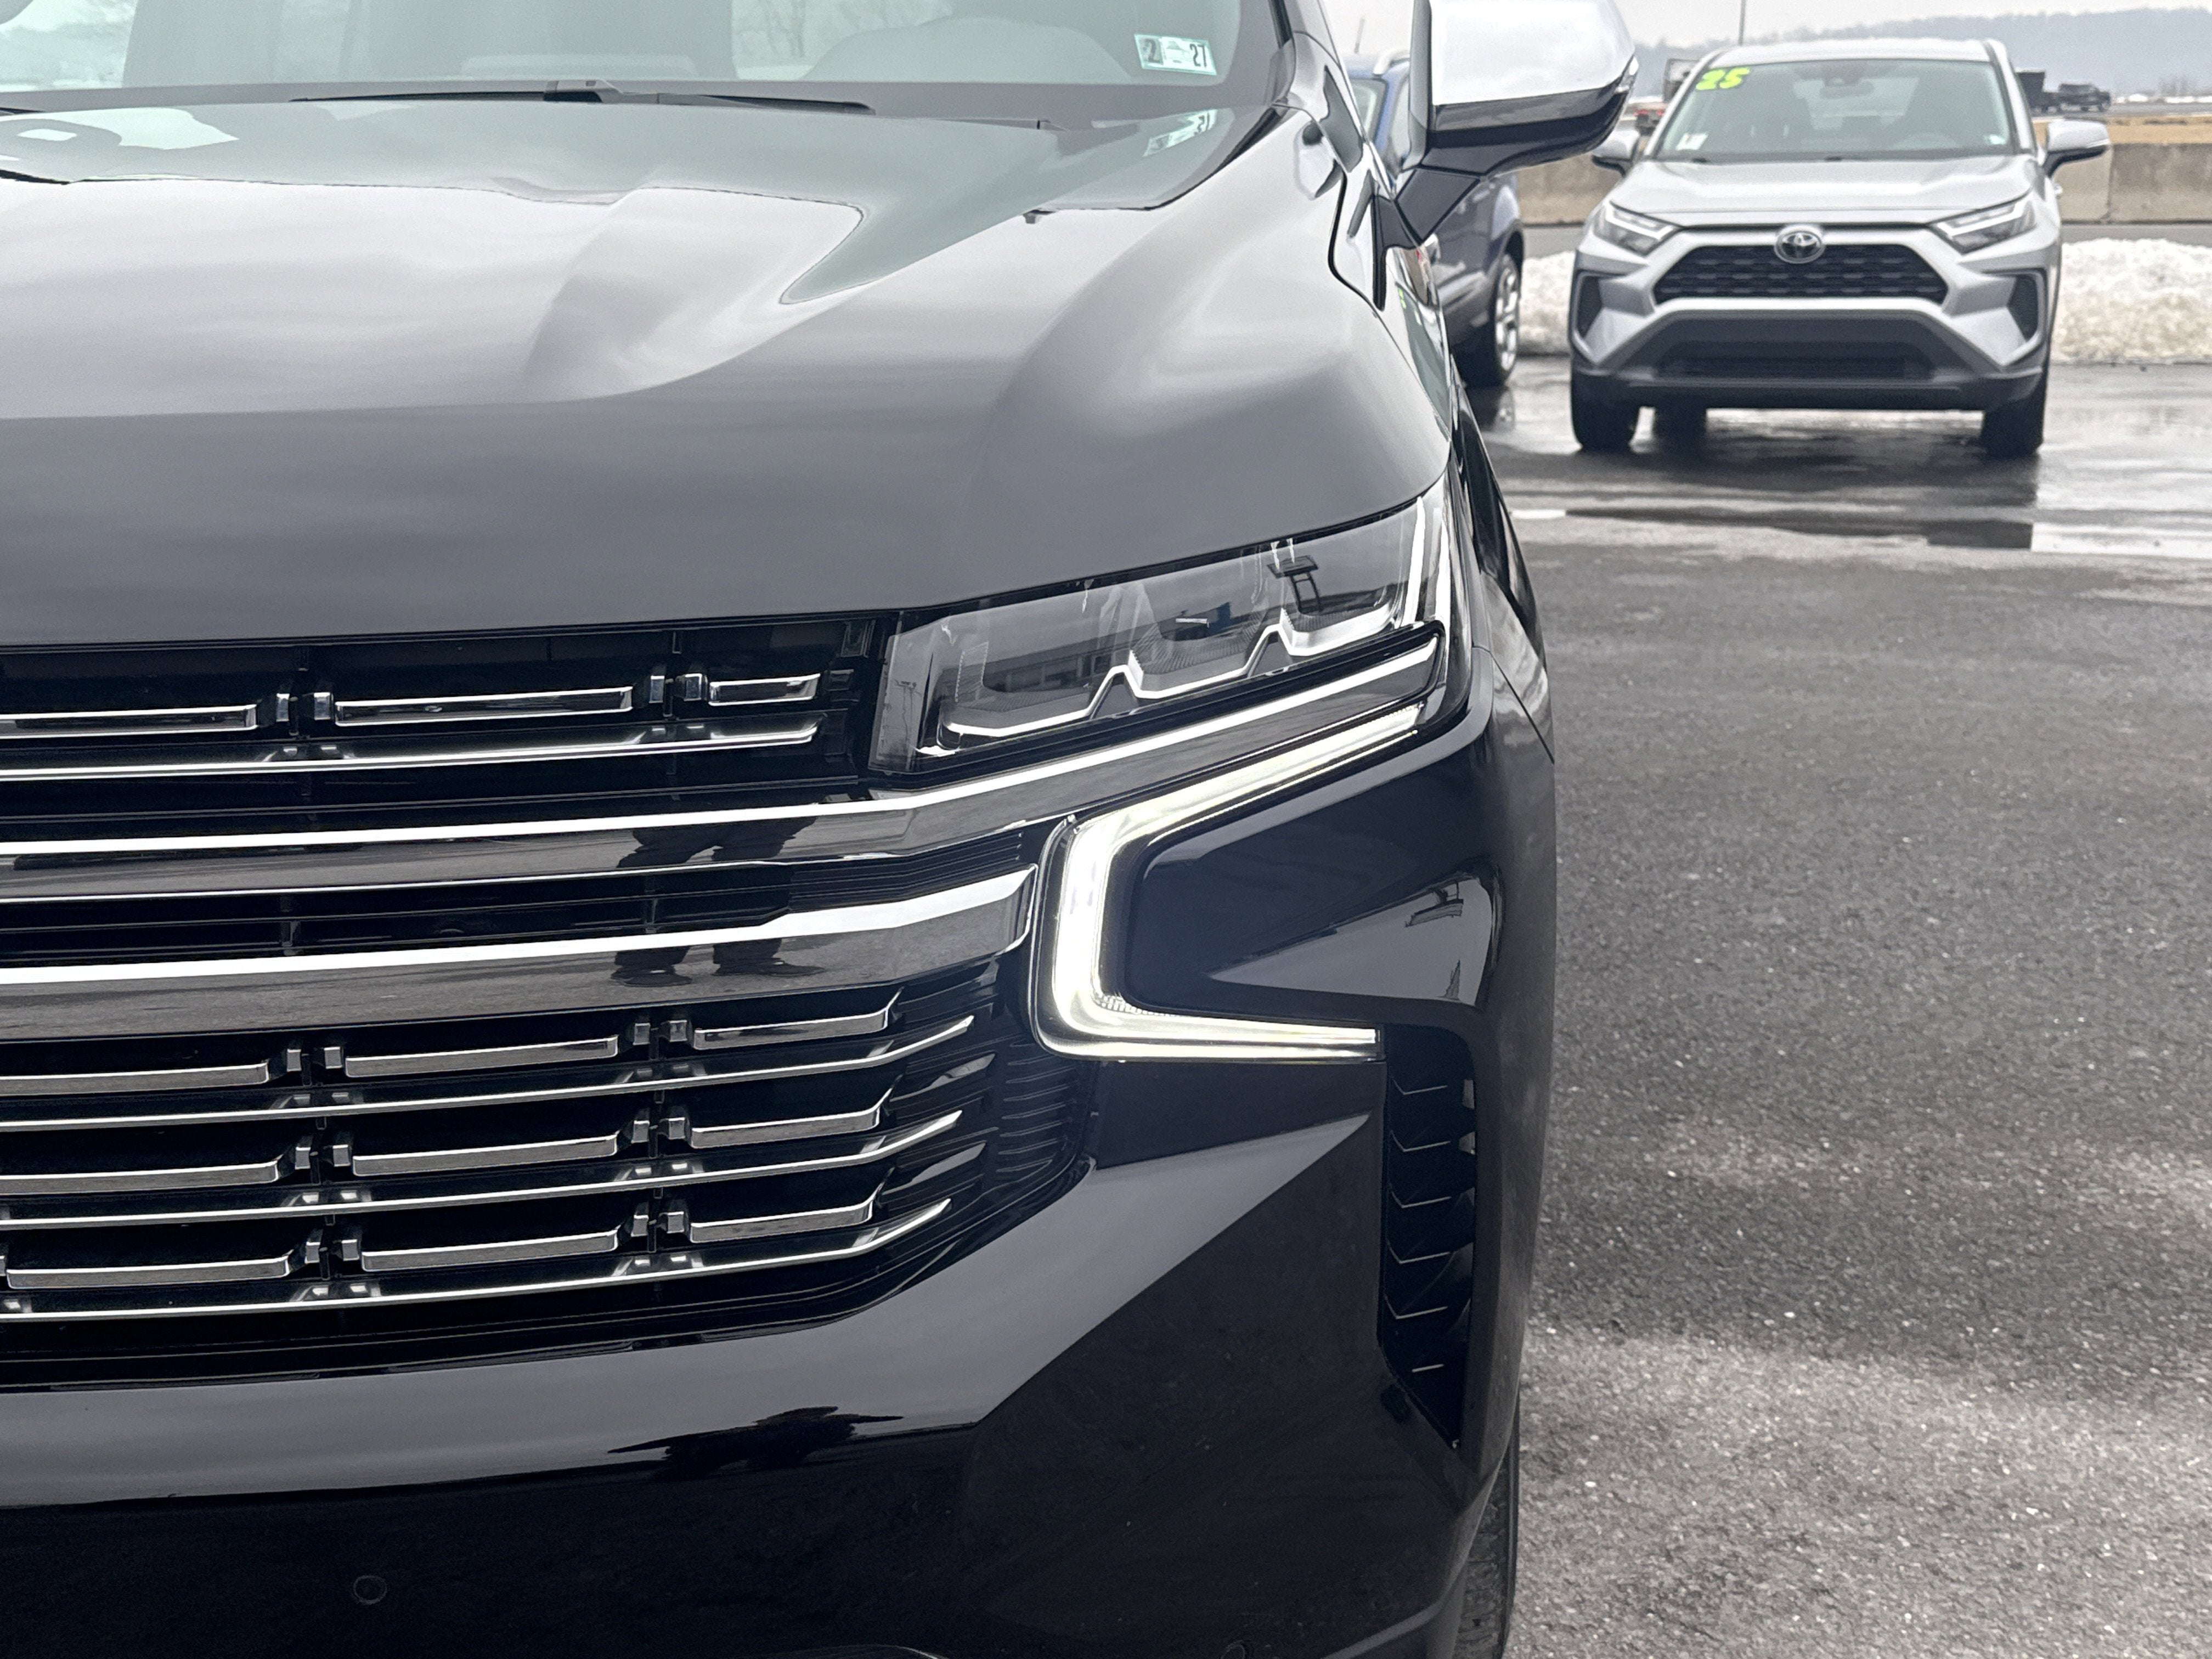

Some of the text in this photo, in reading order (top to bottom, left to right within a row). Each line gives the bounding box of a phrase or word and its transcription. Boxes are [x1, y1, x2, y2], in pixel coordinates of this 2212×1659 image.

[1144, 38, 1207, 67] 2 27
[1695, 67, 1750, 91] 25
